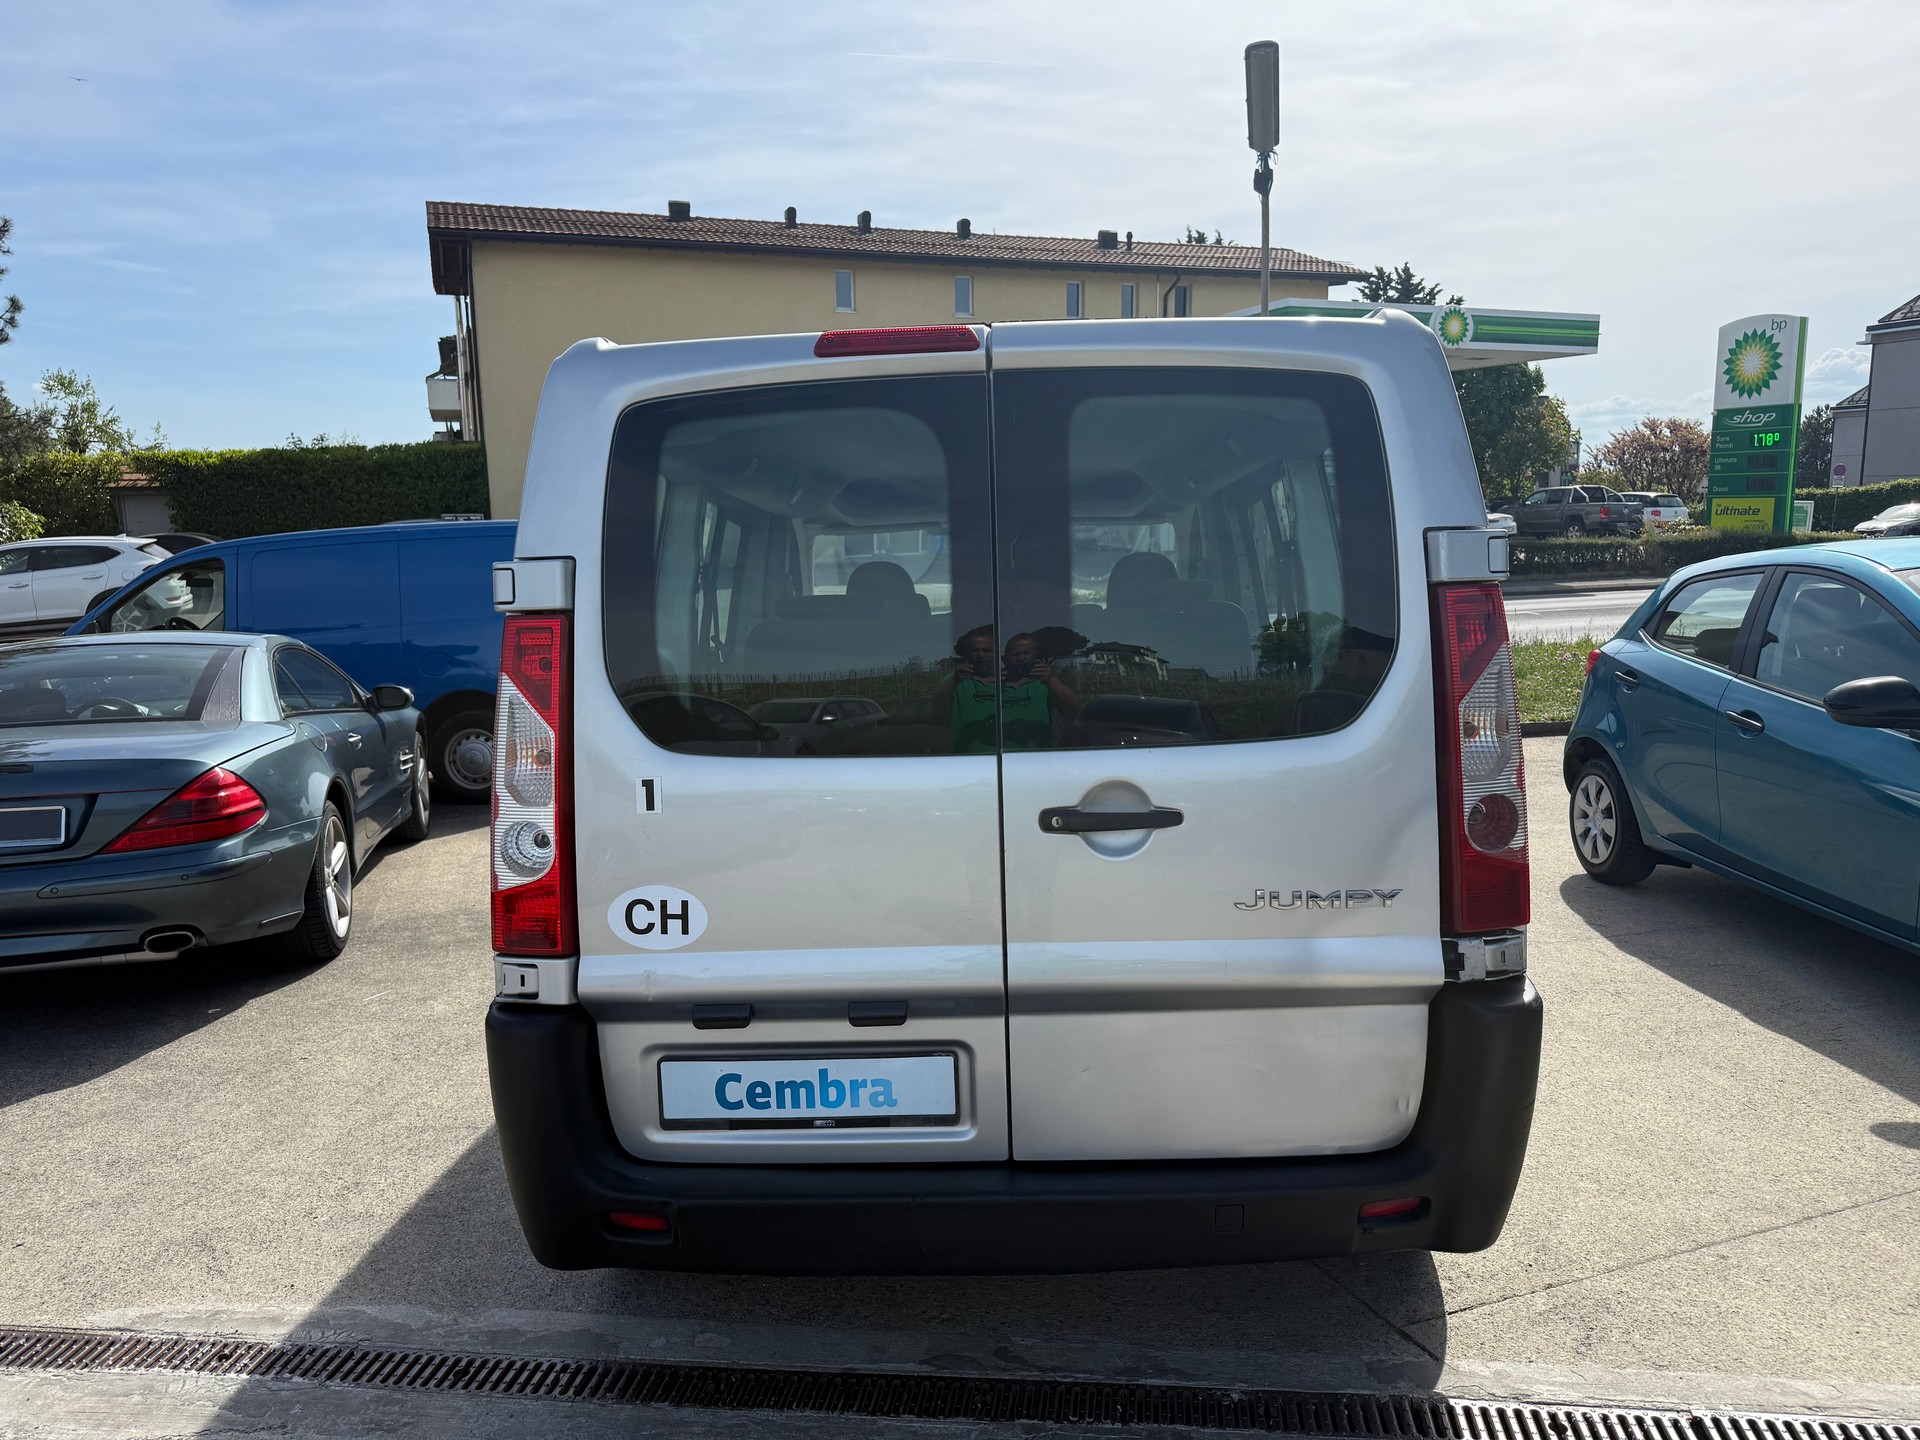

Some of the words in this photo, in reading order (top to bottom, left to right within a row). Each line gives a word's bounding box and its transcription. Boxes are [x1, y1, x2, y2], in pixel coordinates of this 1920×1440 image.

[1771, 319, 1788, 333] bp
[1723, 410, 1776, 427] shop
[1715, 505, 1760, 516] ultimate
[641, 778, 655, 812] 1
[1233, 888, 1404, 911] JUMPY
[624, 898, 690, 936] CH
[714, 1067, 898, 1111] Cembra
